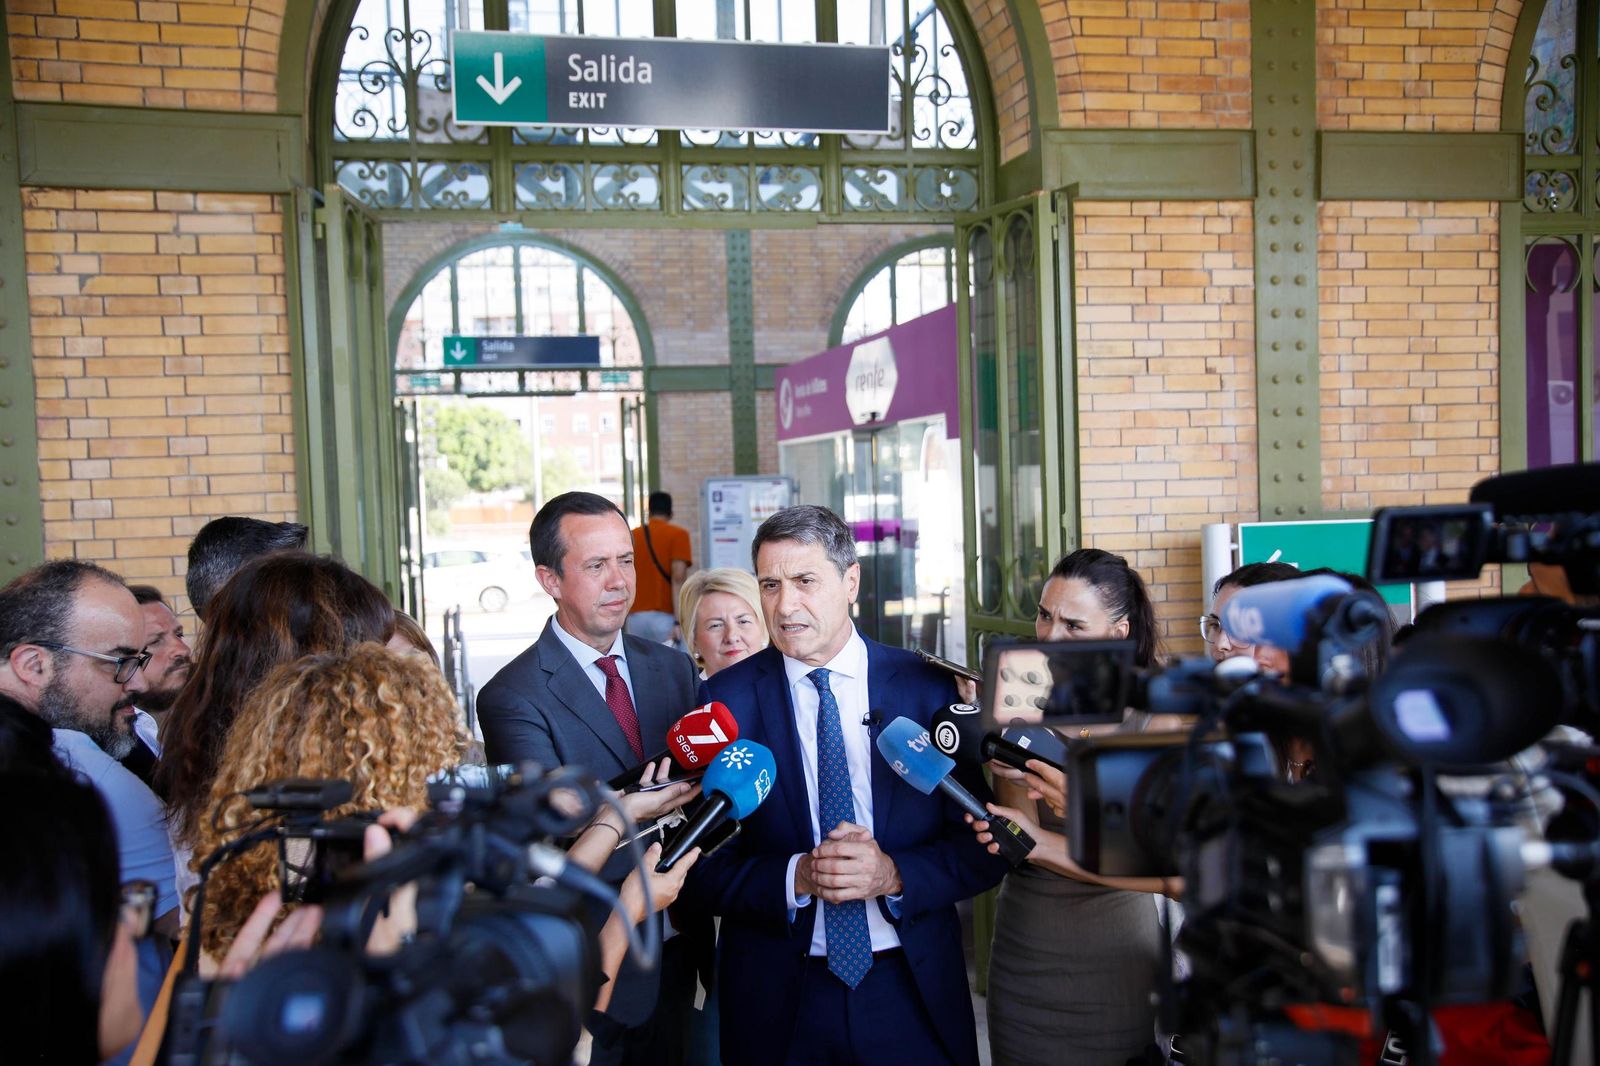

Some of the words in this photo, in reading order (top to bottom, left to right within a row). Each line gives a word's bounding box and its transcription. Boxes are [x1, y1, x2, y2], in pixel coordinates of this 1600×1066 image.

[568, 53, 653, 84] Salida
[568, 91, 608, 109] EXIT
[855, 358, 885, 398] renfe
[676, 734, 699, 763] siete
